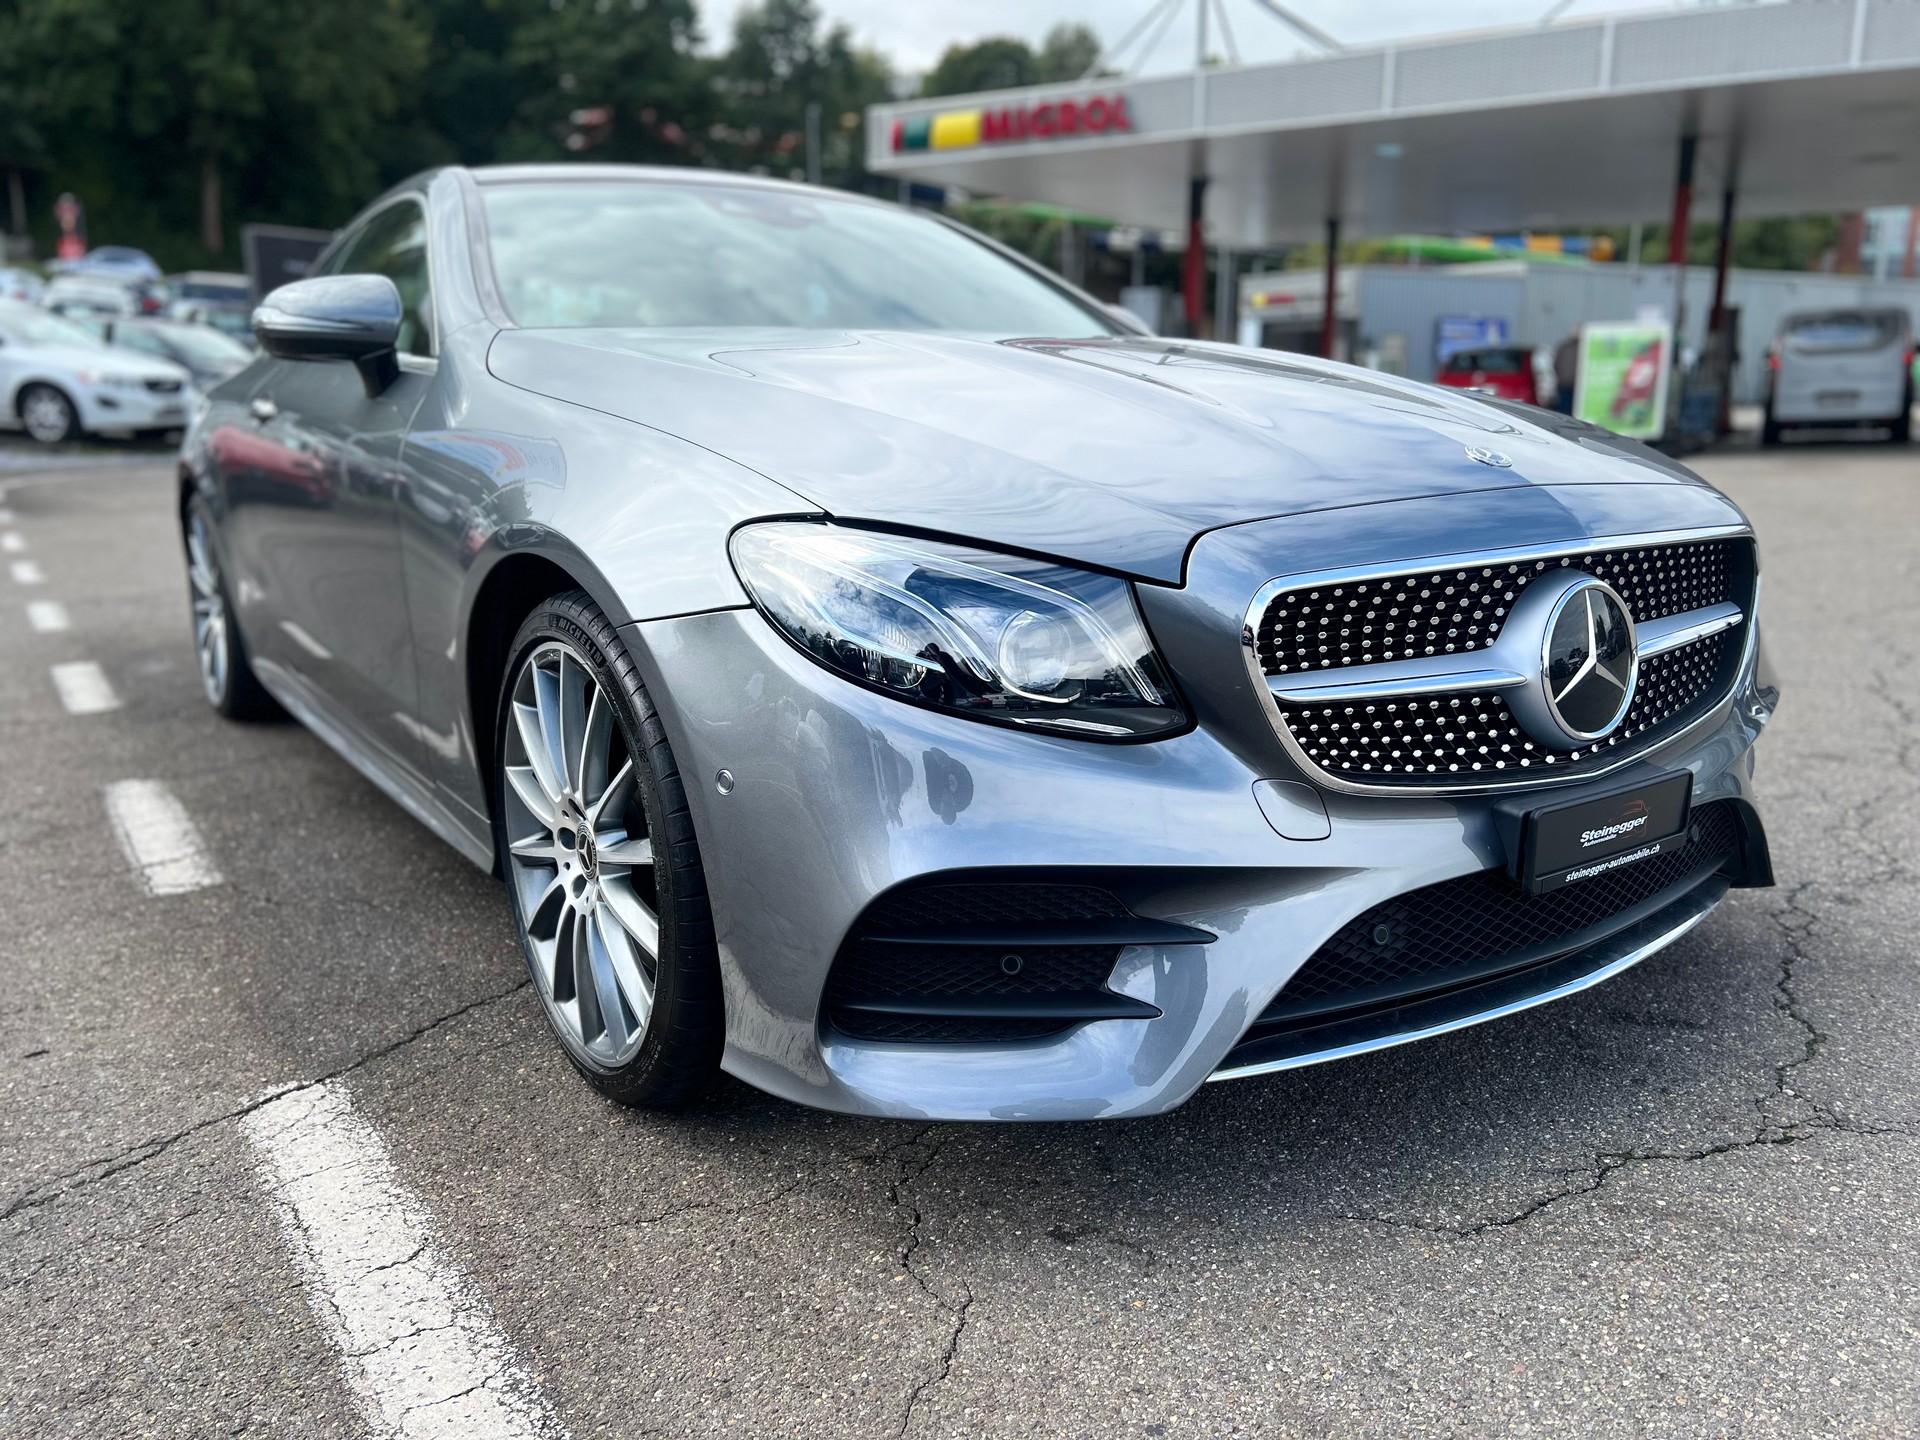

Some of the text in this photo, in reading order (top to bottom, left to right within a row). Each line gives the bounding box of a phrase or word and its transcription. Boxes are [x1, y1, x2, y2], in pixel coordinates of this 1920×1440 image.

[982, 94, 1132, 143] MIGROL
[558, 617, 603, 664] MICHELIN
[1580, 815, 1648, 843] Steinegger
[1582, 834, 1617, 848] Automobile
[1565, 843, 1661, 882] steinegger-automobile.ch
